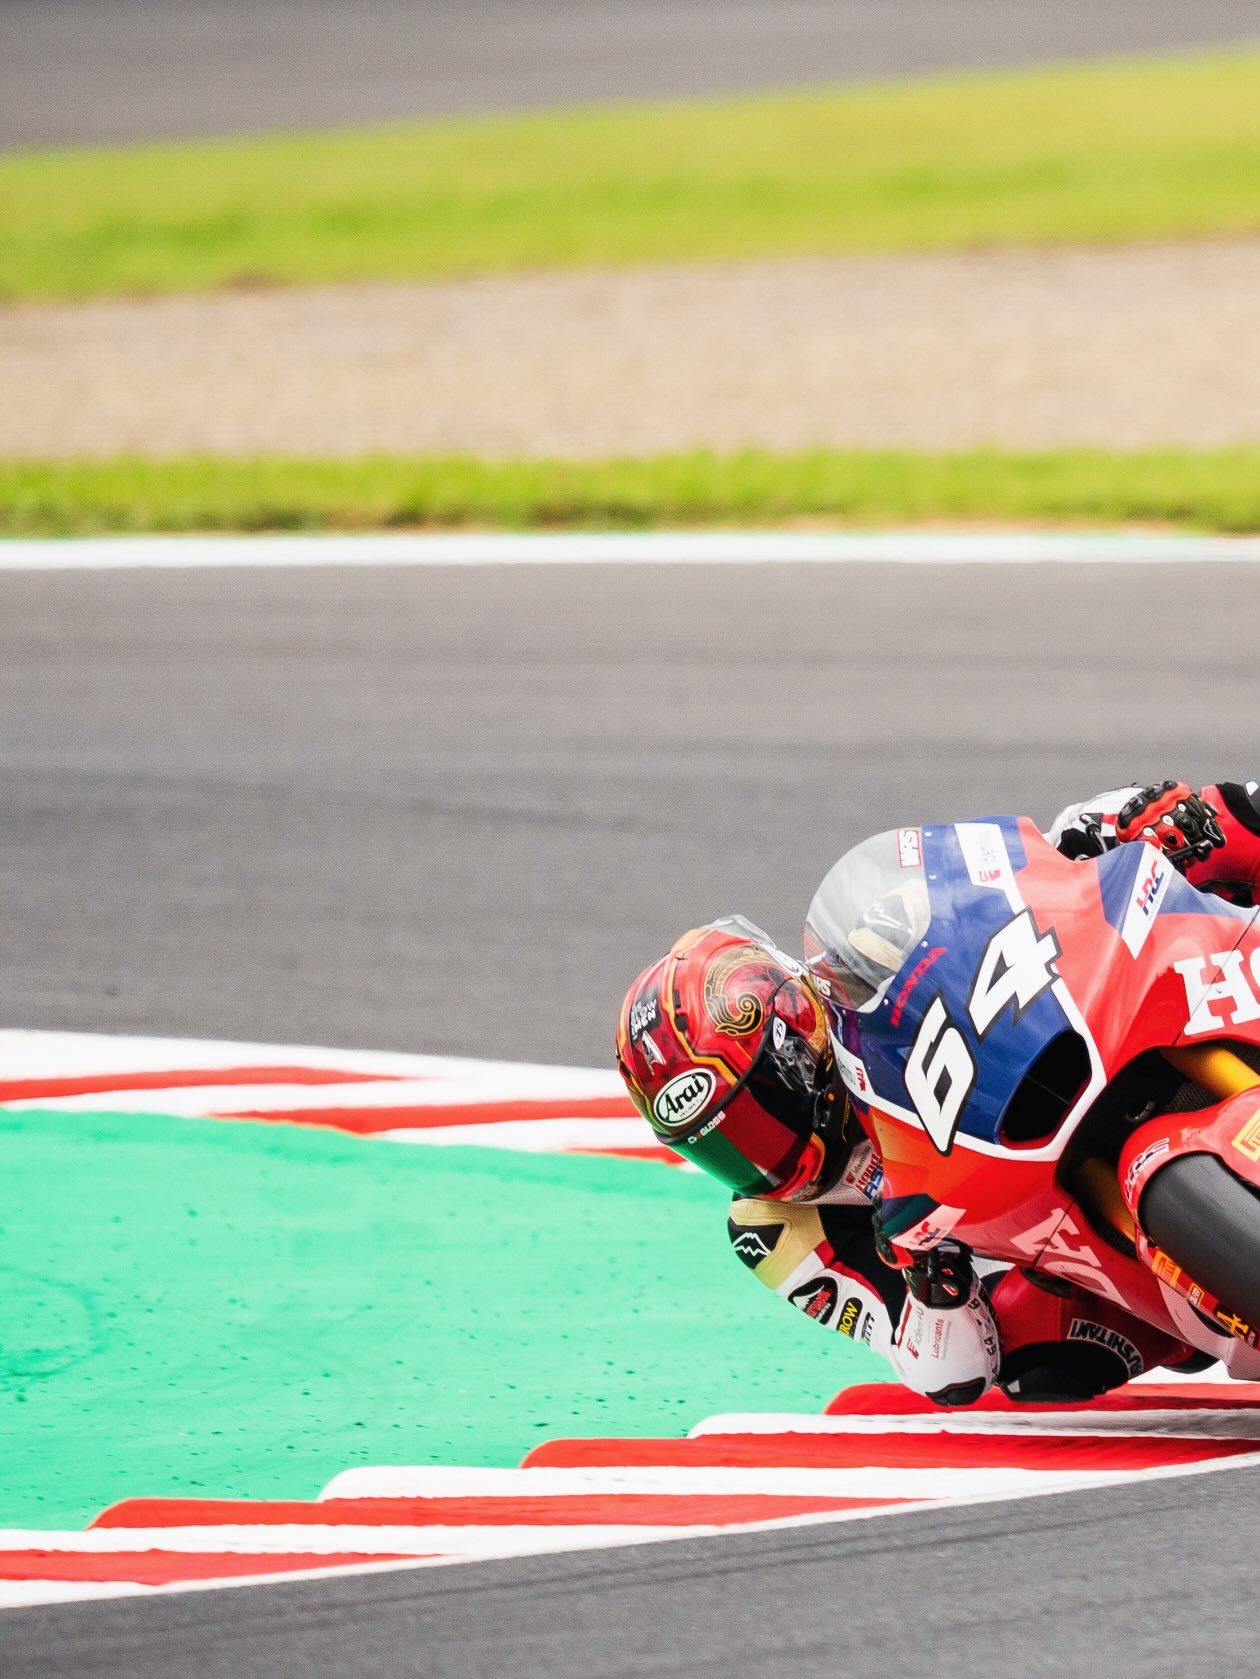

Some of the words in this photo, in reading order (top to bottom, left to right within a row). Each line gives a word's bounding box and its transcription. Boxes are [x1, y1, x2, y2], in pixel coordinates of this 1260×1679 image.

[1136, 860, 1164, 916] HRC
[890, 946, 947, 1027] HONDA
[905, 909, 1058, 1153] 64
[665, 1074, 704, 1121] Arai
[855, 1153, 881, 1193] Hond
[839, 1301, 859, 1336] ROW
